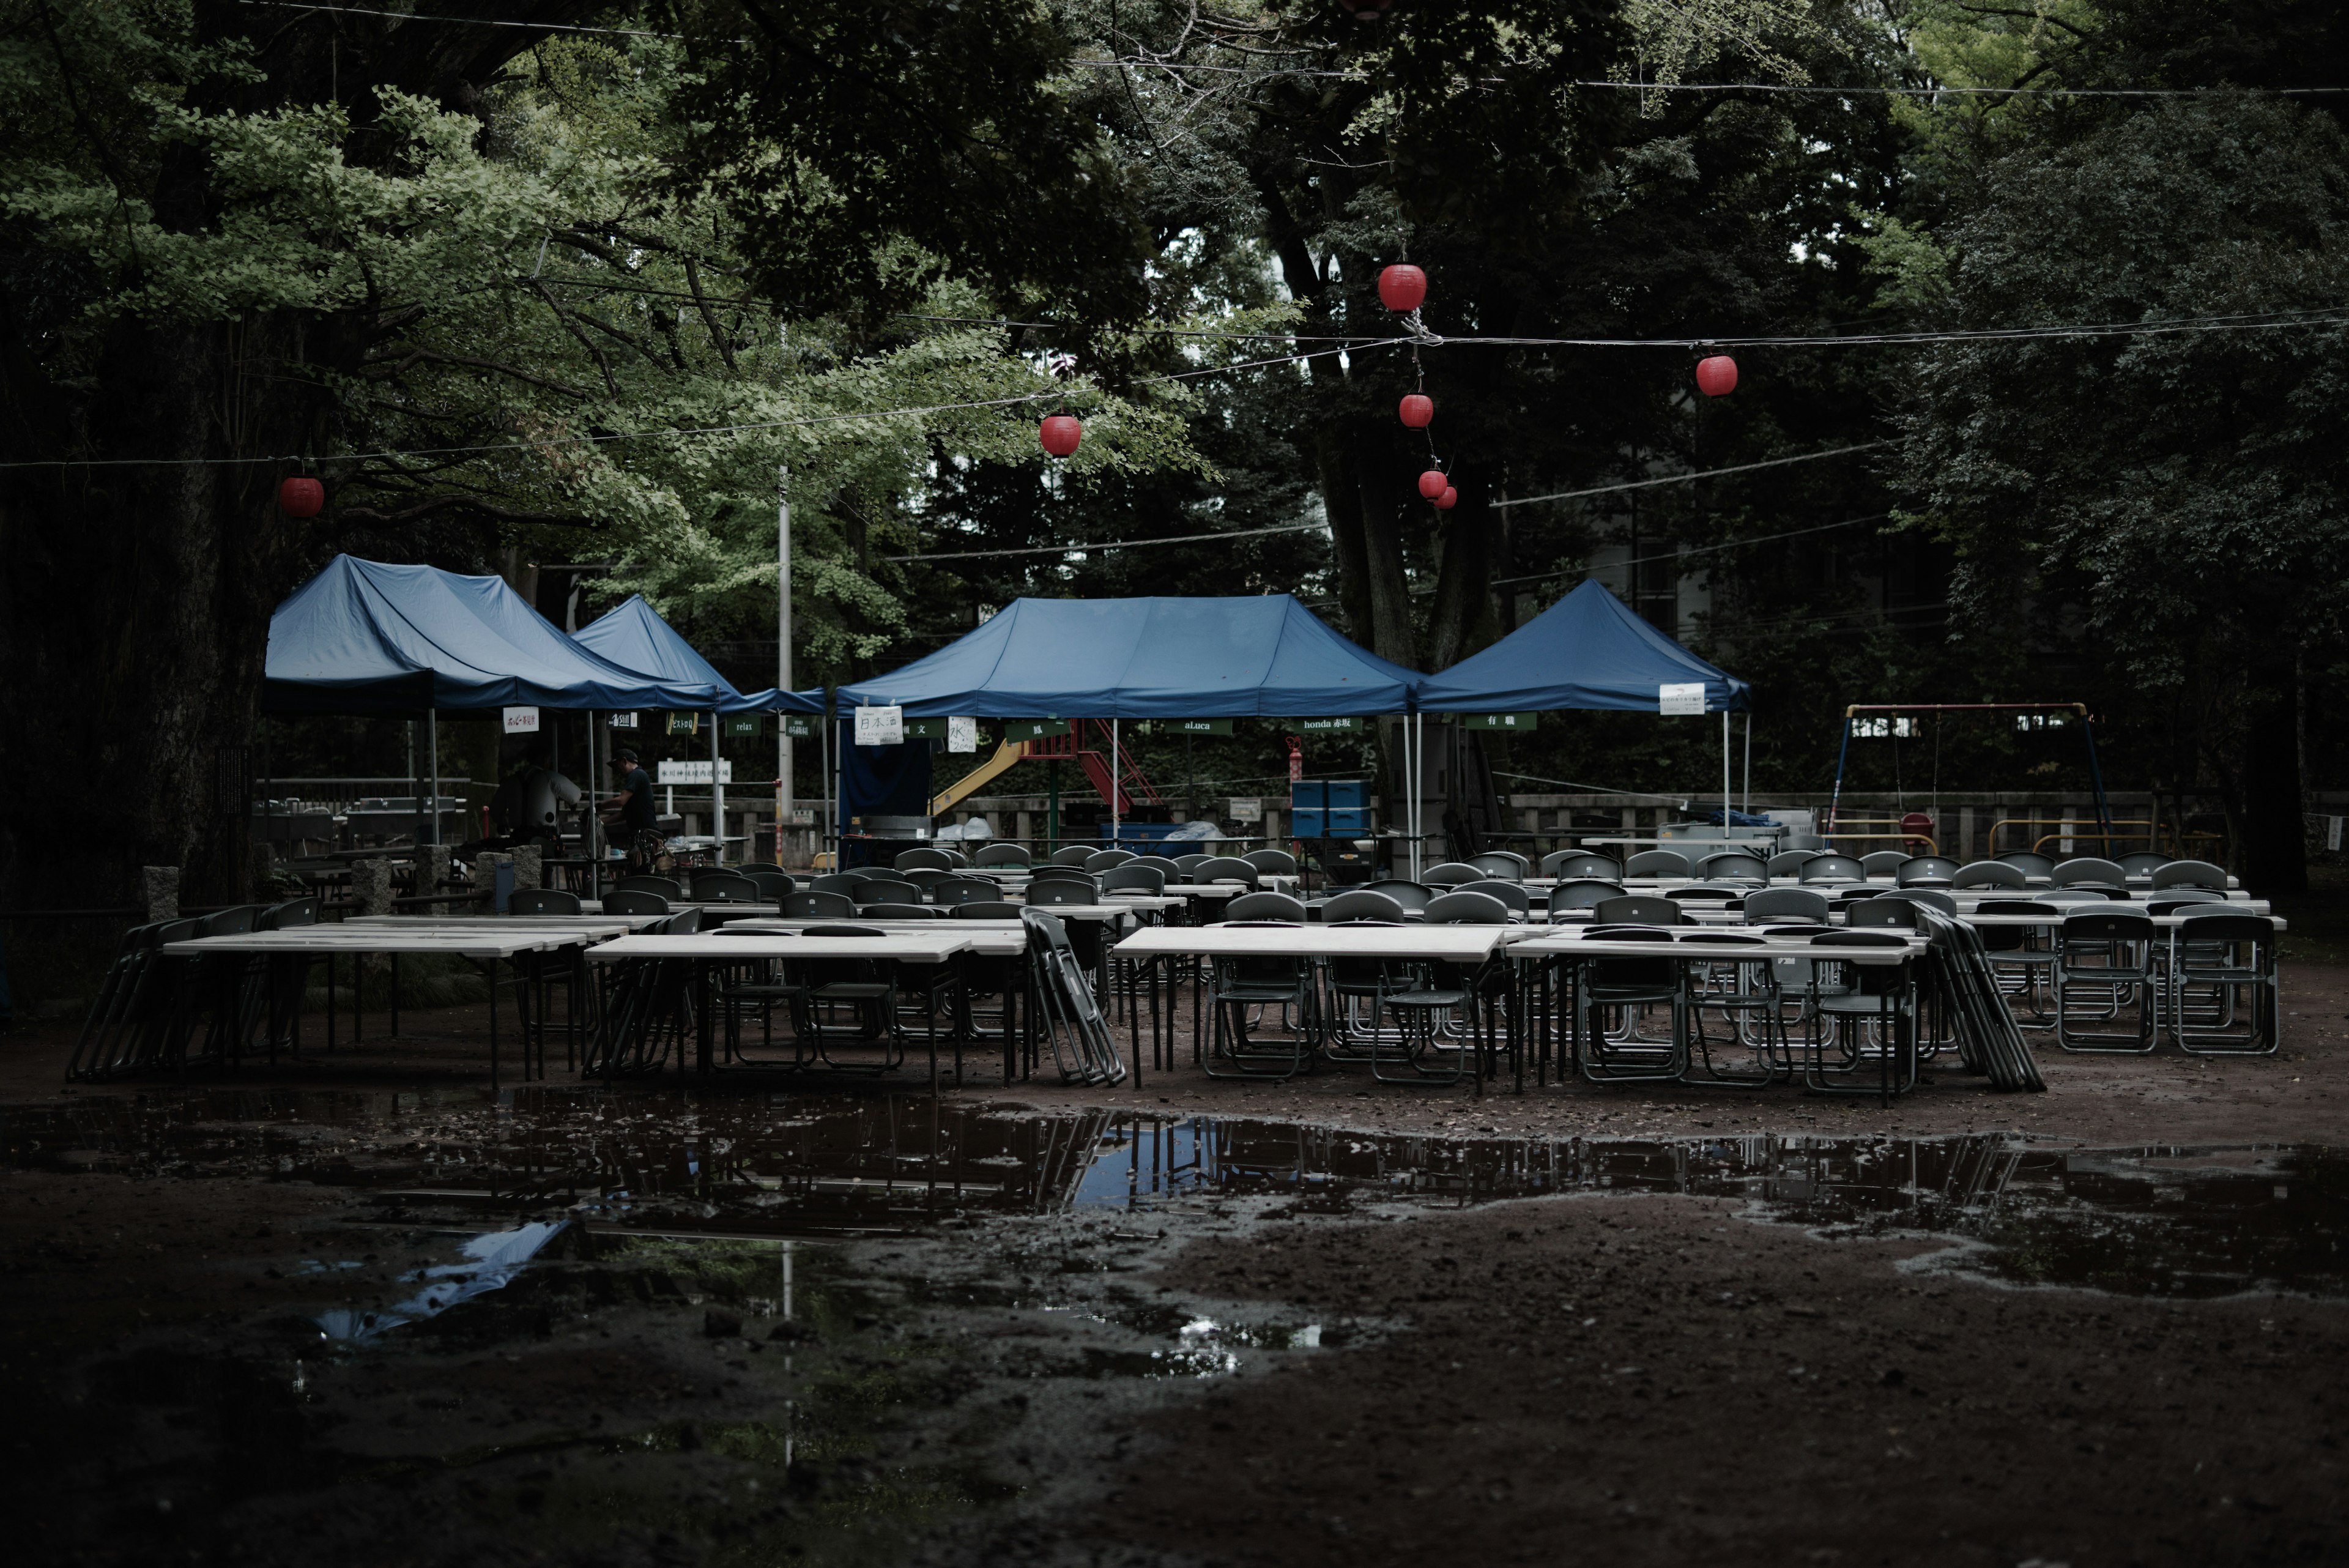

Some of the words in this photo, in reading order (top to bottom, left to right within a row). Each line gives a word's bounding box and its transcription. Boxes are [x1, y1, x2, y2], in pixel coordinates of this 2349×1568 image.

[673, 719, 692, 729] ビストロQ
[737, 722, 752, 731] relax
[861, 716, 897, 730] 日本酒
[1185, 721, 1211, 730] aLuca
[1304, 719, 1331, 729] honda
[1333, 718, 1351, 728] 赤坂
[950, 724, 965, 738] 水
